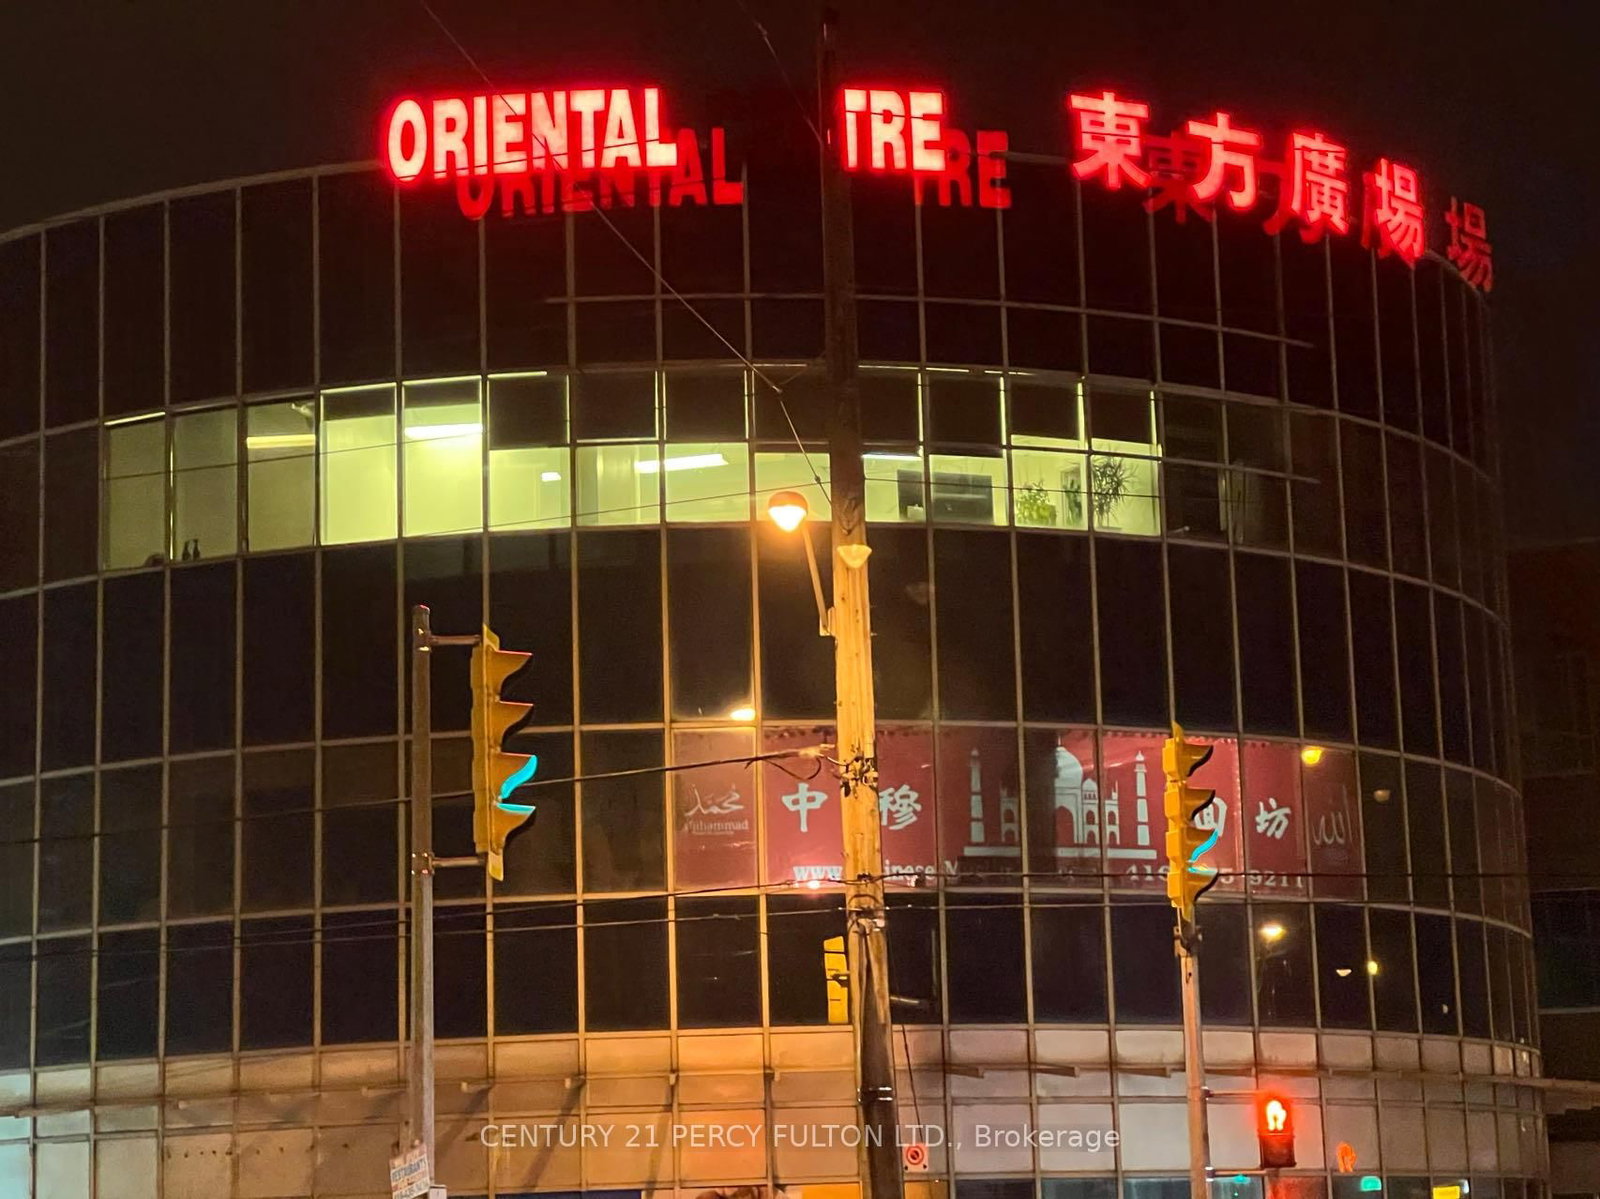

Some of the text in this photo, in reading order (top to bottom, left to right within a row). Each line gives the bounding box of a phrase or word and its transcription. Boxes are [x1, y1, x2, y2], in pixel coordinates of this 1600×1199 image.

[387, 87, 946, 182] ORIENTAL TRE
[1070, 91, 1425, 264] 東方廣場
